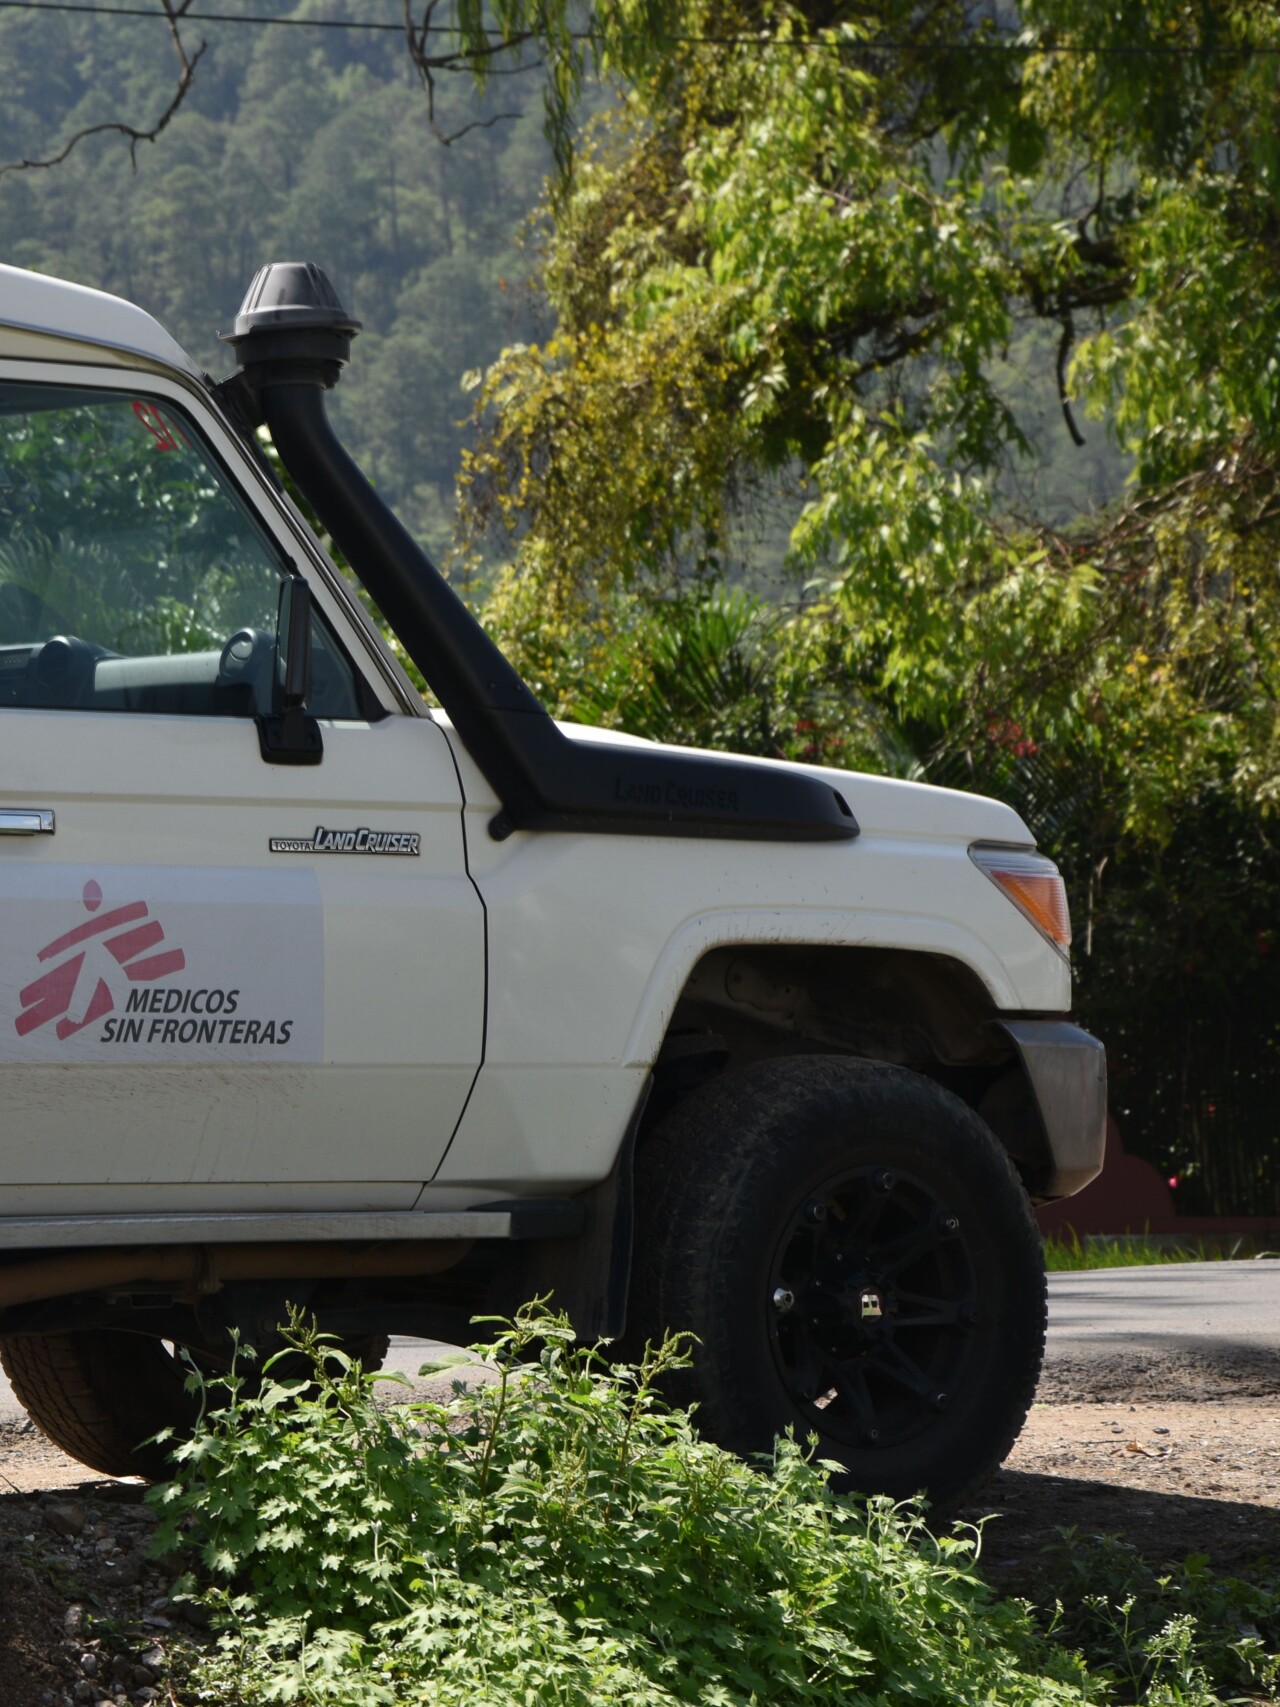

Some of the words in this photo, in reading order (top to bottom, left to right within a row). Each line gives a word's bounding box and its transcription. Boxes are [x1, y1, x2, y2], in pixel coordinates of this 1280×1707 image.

[273, 840, 310, 851] TOYOTA
[125, 988, 239, 1014] MEDICOS
[101, 1018, 144, 1044] SIN
[147, 1019, 293, 1045] FRONTERAS
